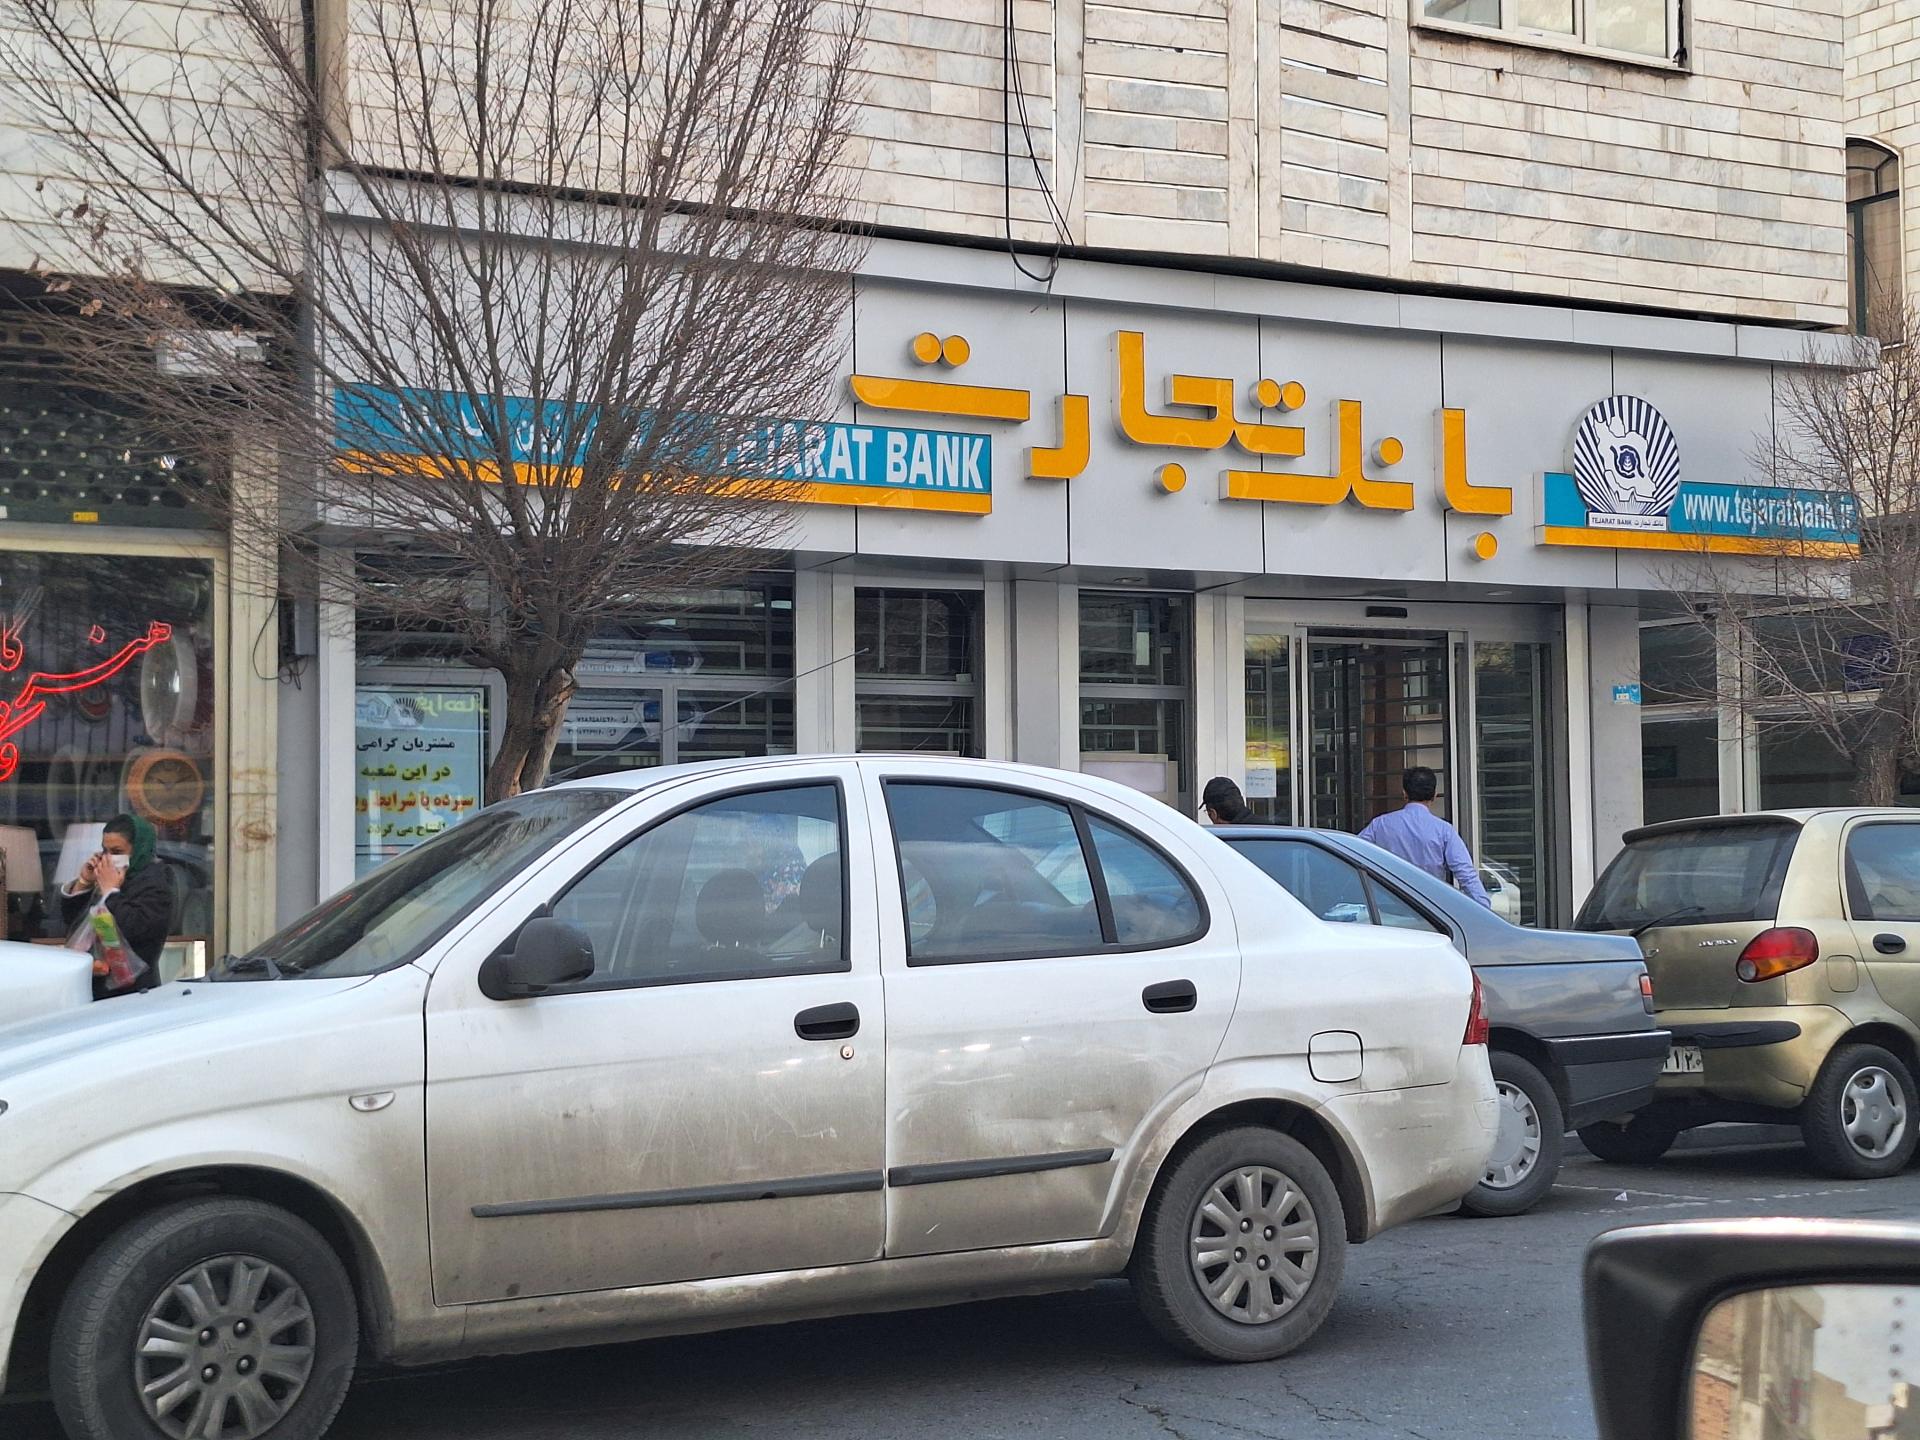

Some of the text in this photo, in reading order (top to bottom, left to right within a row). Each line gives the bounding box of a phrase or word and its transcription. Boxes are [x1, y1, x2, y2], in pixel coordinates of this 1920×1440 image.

[848, 331, 1513, 561] بانک تجارت
[886, 431, 984, 489] BANK
[1592, 517, 1615, 525] TEJARAT
[402, 737, 456, 752] مشتریان
[361, 764, 451, 781] در این شعبه
